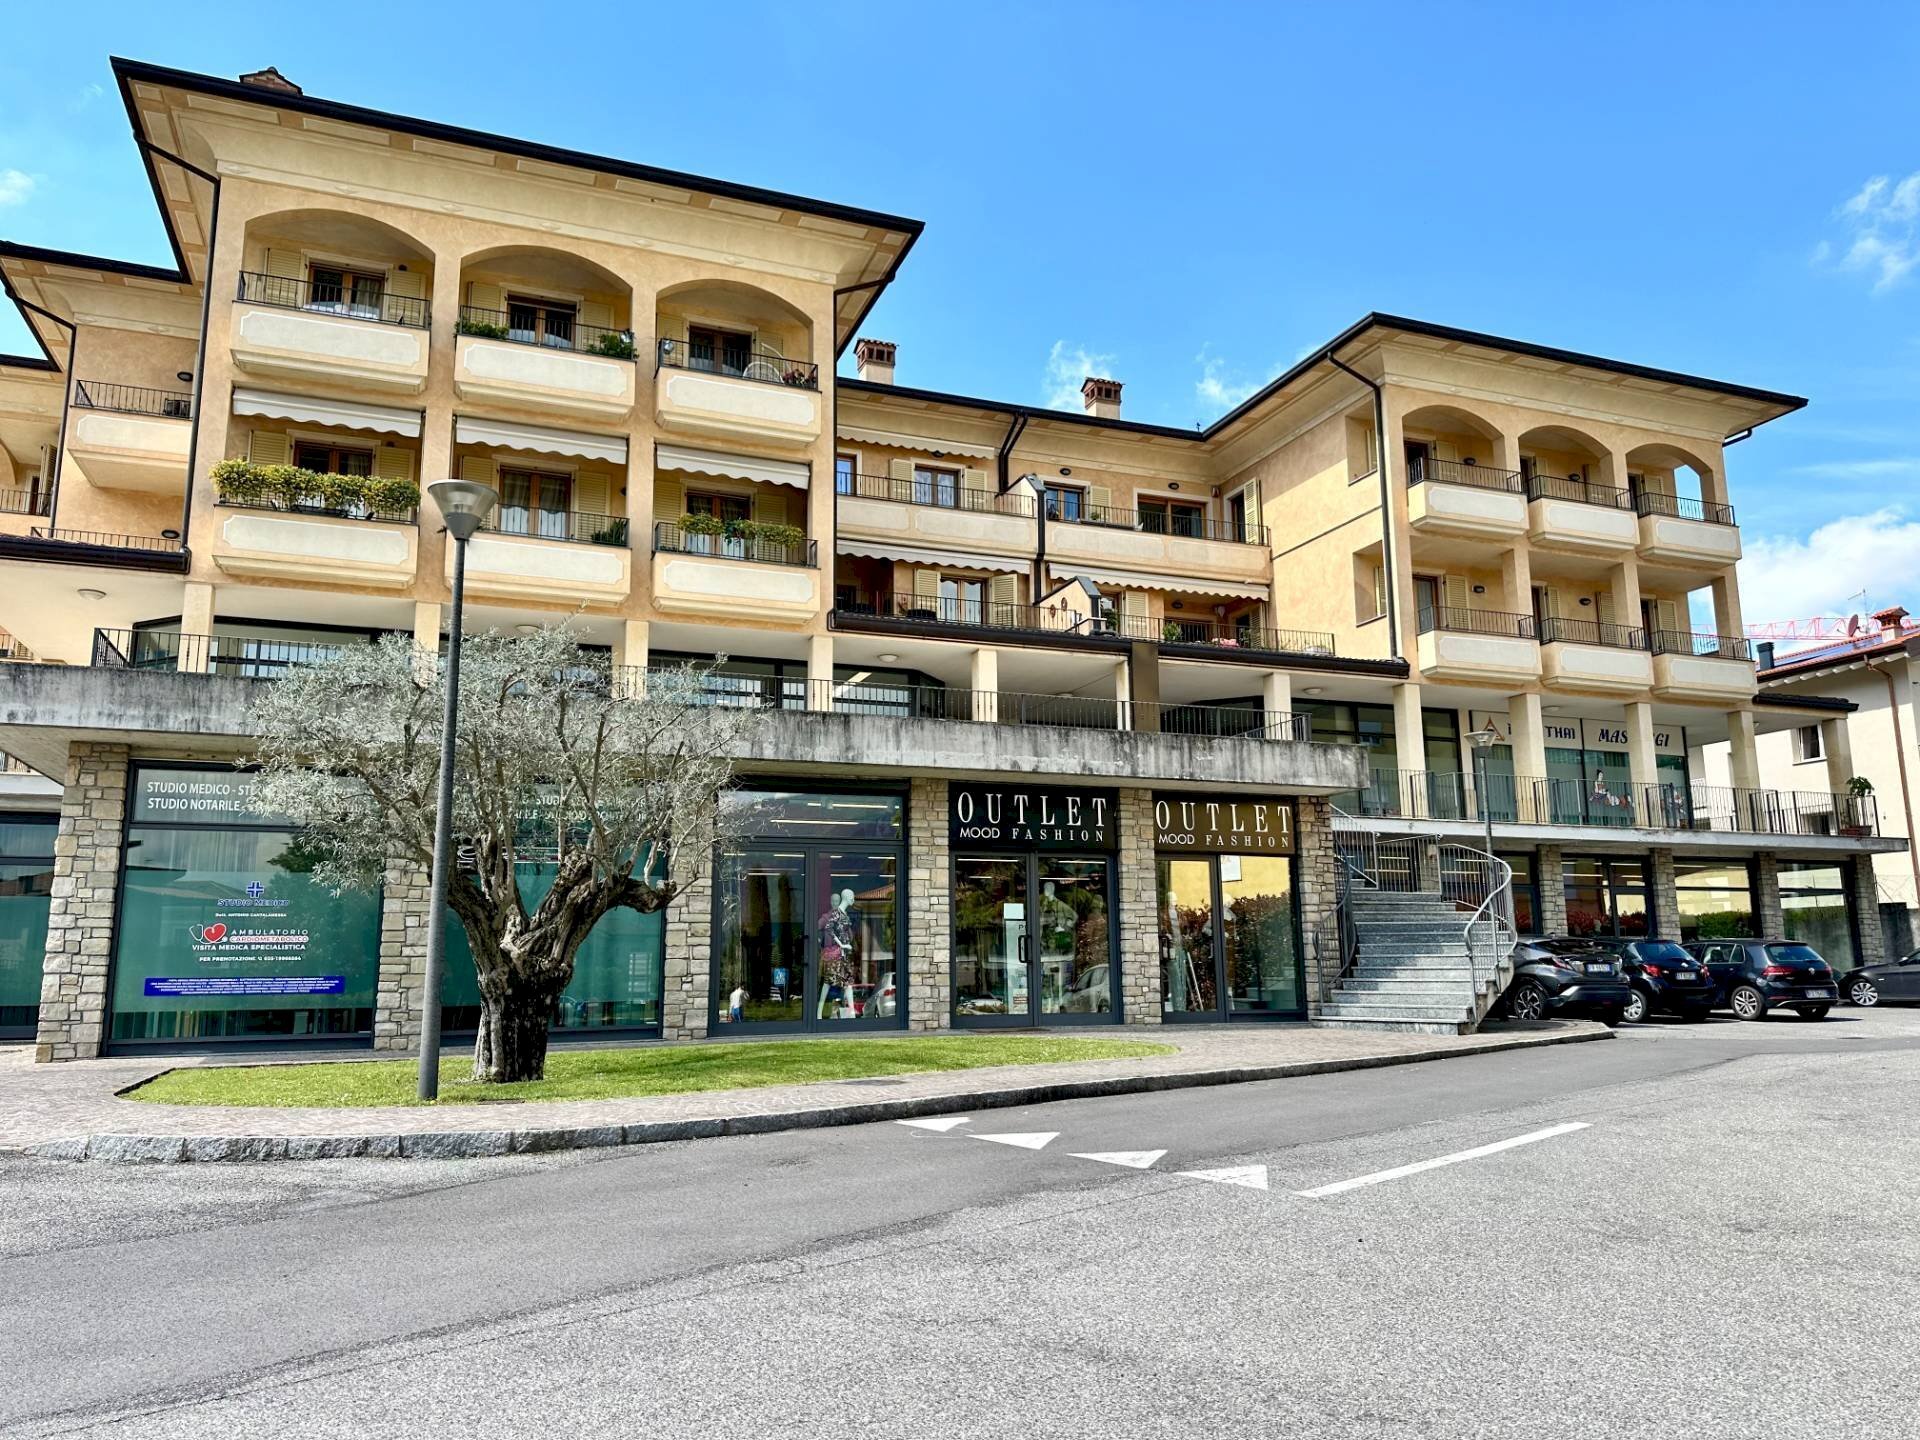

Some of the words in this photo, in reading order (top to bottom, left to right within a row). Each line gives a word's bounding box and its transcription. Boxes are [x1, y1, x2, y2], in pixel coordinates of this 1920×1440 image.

[1545, 725, 1576, 740] THAI
[1598, 728, 1670, 747] MASGI
[147, 782, 187, 794] STUDIO
[189, 783, 230, 795] MEDICO
[148, 798, 188, 810] STUDIO
[190, 799, 241, 811] NOTARILE
[957, 791, 1108, 827] OUTLET
[1155, 800, 1291, 834] OUTLET
[959, 826, 1001, 839] MOOD
[1011, 827, 1105, 842] FASHION
[1158, 832, 1195, 846] MOOD
[1205, 834, 1290, 848] FASHION
